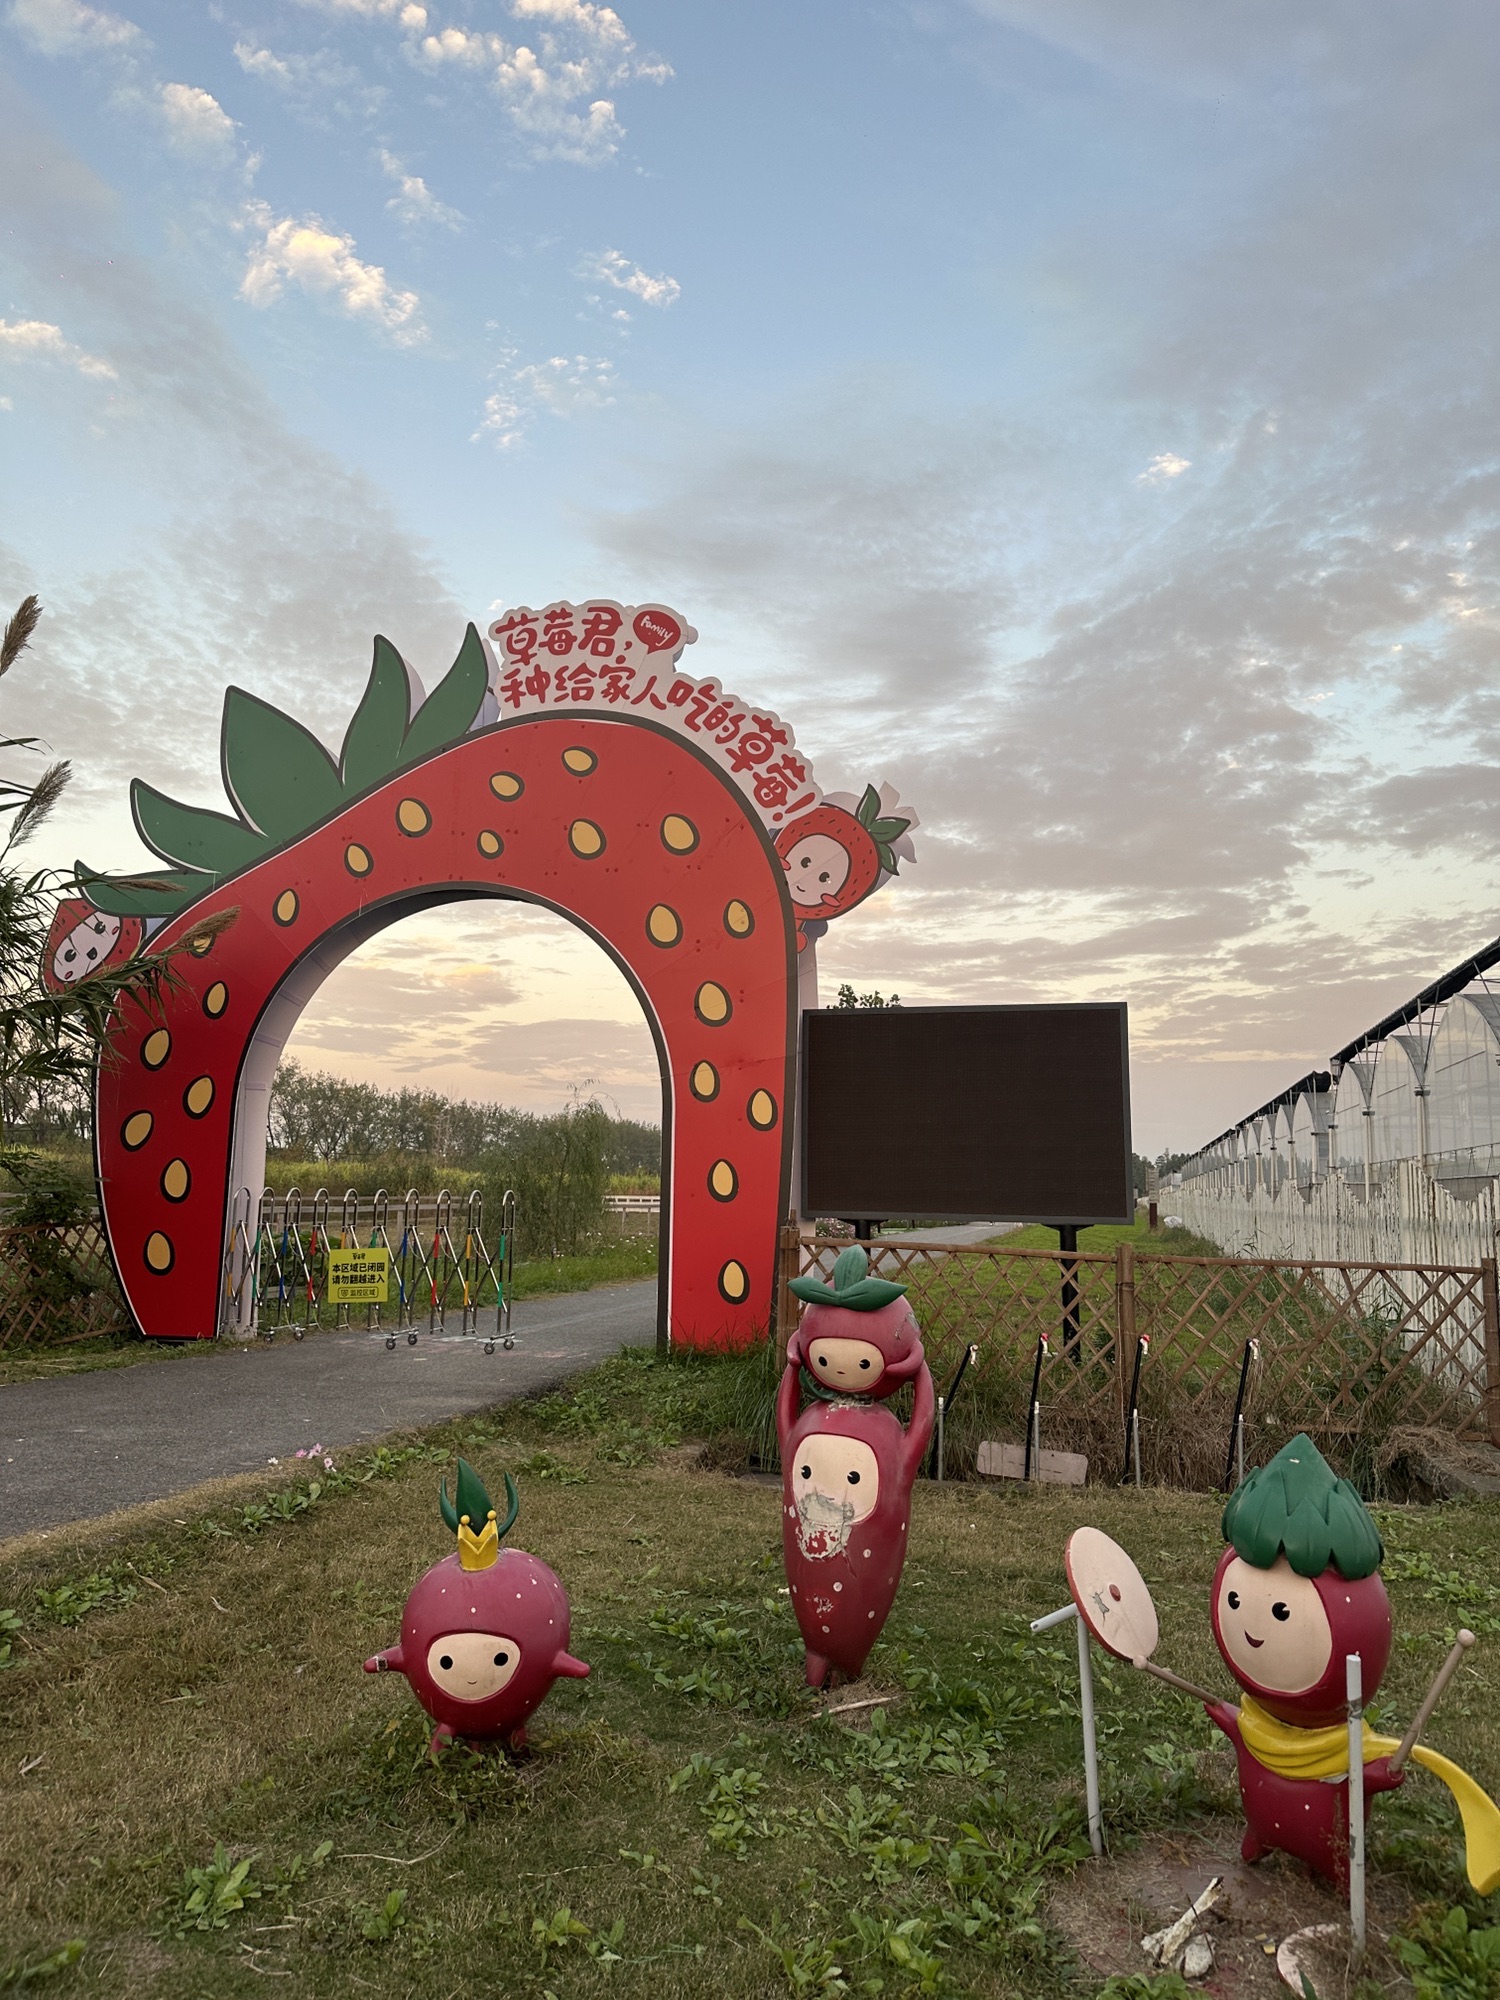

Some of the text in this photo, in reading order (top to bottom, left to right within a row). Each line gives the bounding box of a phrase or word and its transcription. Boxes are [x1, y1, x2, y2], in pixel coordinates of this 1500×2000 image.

[332, 1262, 385, 1273] 本区域已闭园
[332, 1274, 385, 1285] 请勿翻越进入
